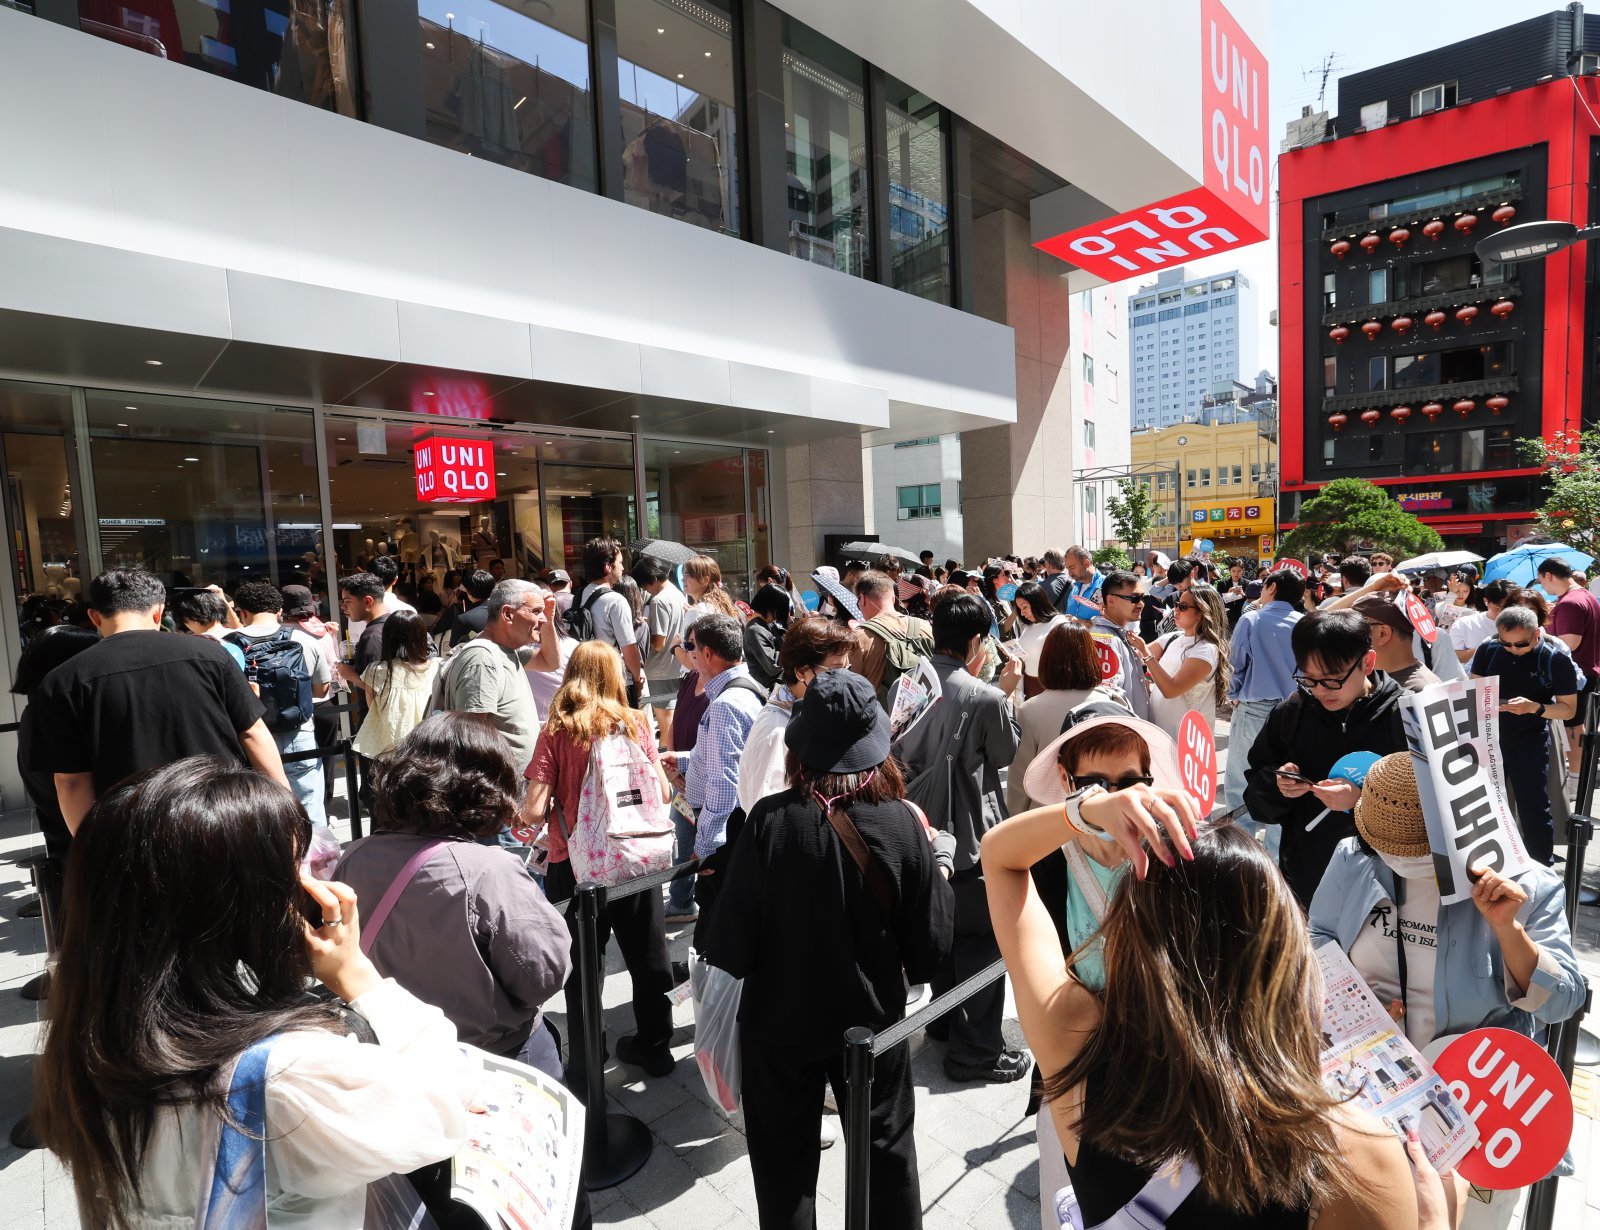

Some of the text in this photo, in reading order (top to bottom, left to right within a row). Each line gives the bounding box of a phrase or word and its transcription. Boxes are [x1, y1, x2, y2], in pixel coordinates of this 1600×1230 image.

[1210, 19, 1258, 130] UNI
[1212, 108, 1263, 206] QLO
[1069, 205, 1207, 256] QLO
[1108, 227, 1240, 271] UNI
[416, 446, 432, 469] UNI
[441, 445, 484, 467] UNI
[418, 470, 434, 496] QLO
[443, 469, 489, 493] QLO
[1410, 601, 1427, 620] QLO
[1417, 618, 1435, 636] UNI
[1186, 718, 1211, 769] UNI
[1184, 753, 1210, 802] QLO
[1484, 685, 1520, 855] UNIQLO GLOBAL FLAGSHIP STORE MYEONGDONG
[1383, 927, 1416, 943] LONG
[1466, 1036, 1553, 1127] UNI
